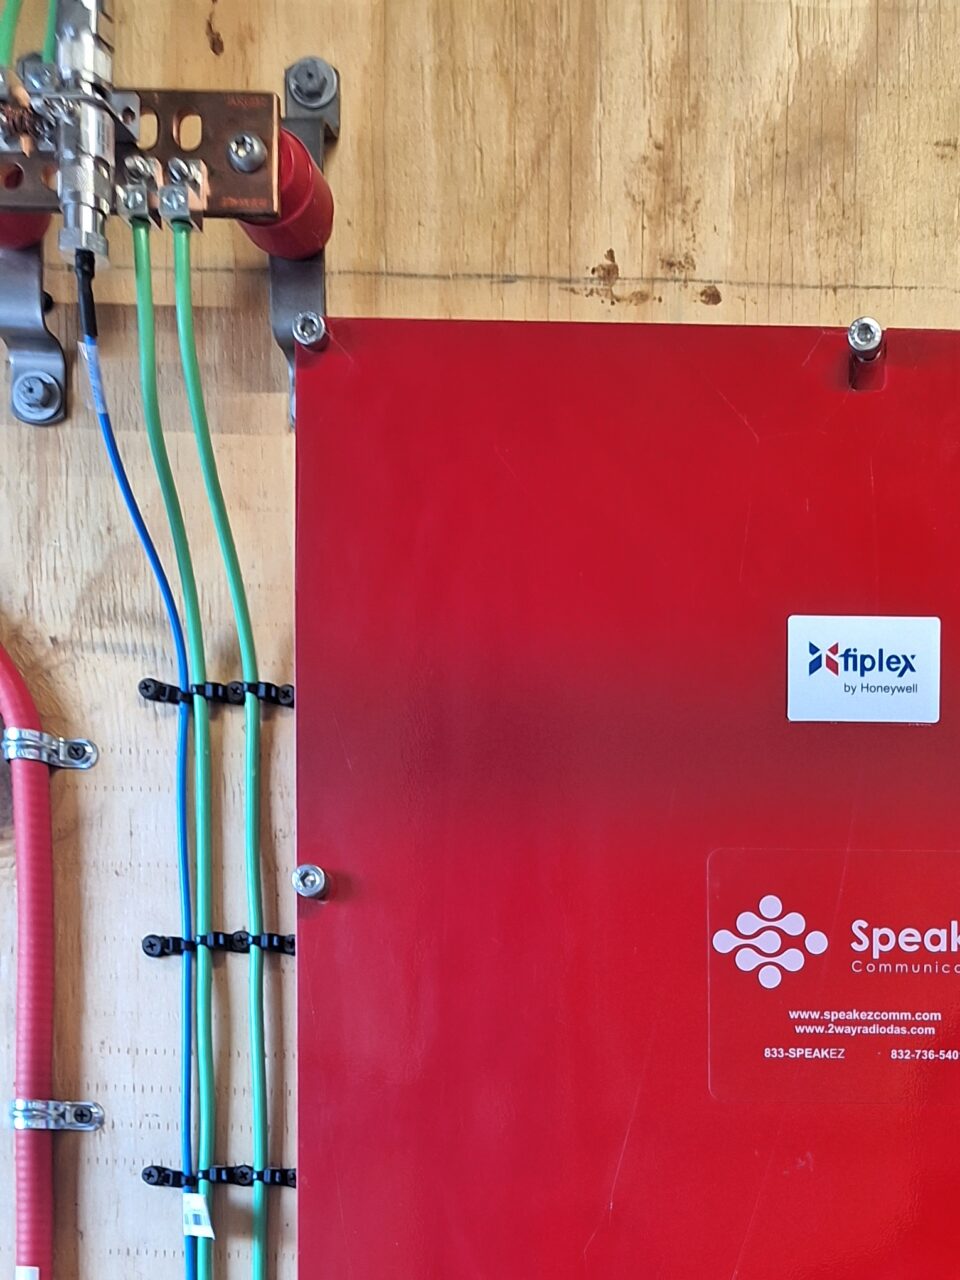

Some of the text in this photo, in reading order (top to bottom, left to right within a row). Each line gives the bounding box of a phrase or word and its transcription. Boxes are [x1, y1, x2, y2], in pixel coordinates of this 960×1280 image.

[838, 647, 917, 678] fiplex
[843, 682, 919, 696] by Honeywell
[788, 1009, 942, 1022] www.speakezcomm.com
[794, 1023, 936, 1036] www.2wayradiodas.com
[763, 1047, 846, 1059] 833-SPEAKEZ
